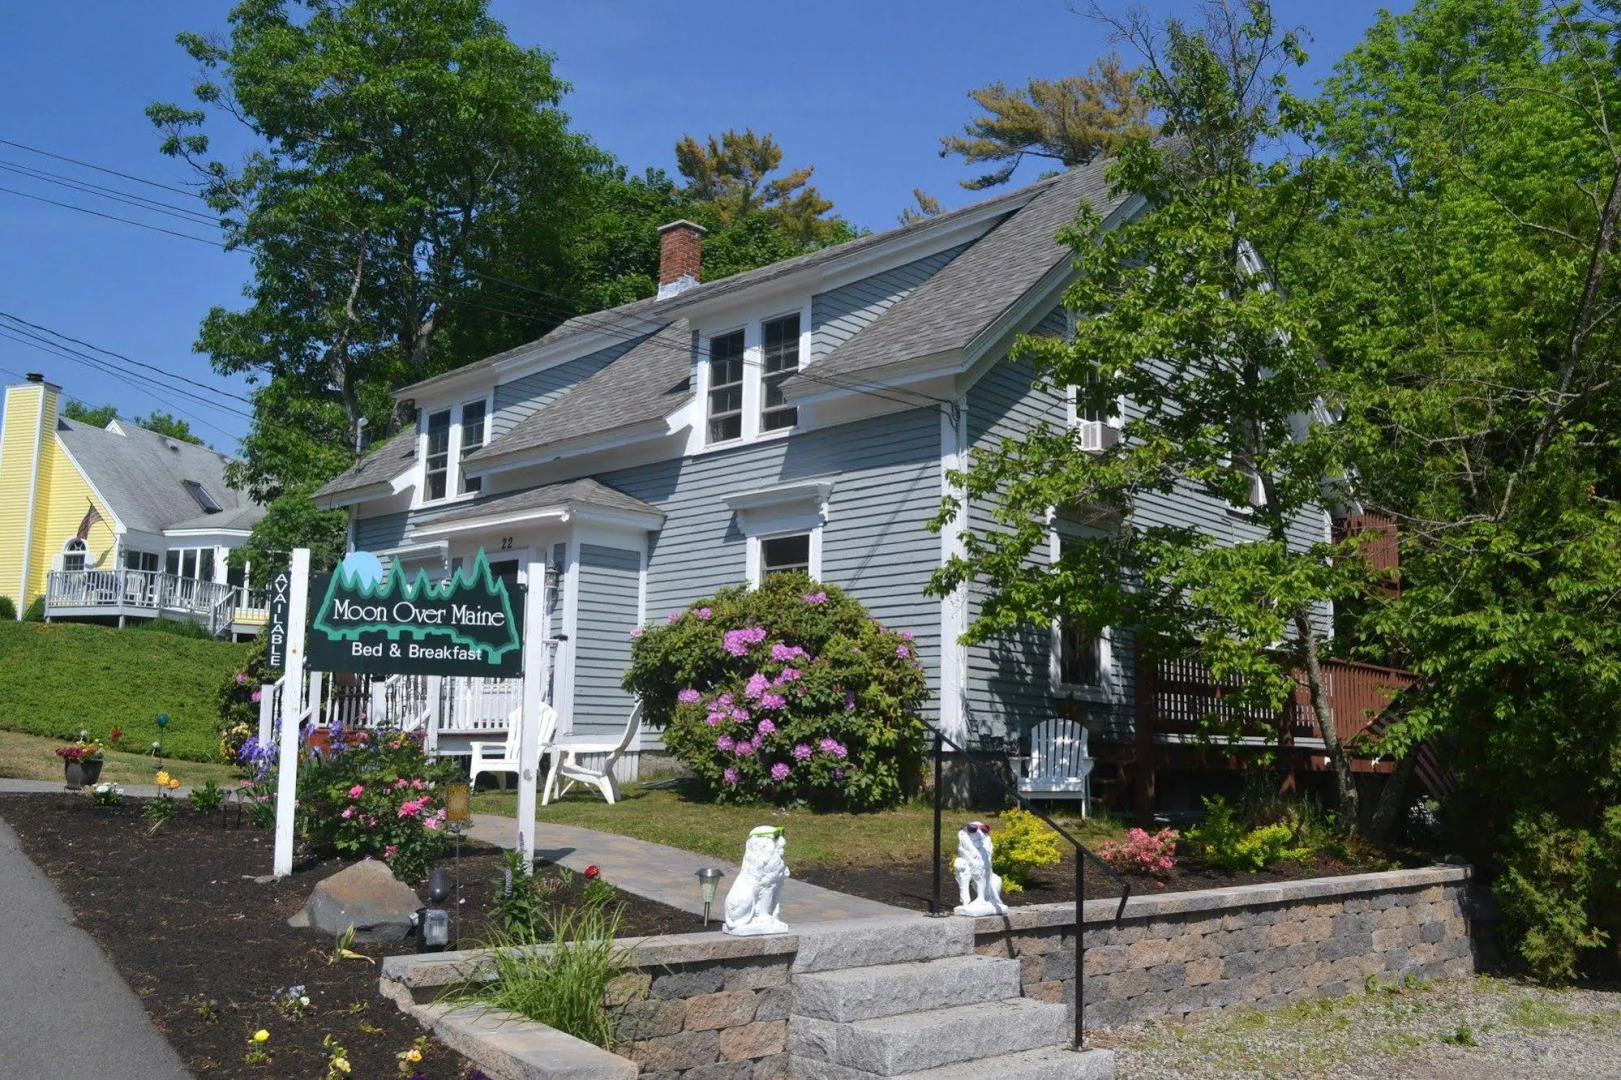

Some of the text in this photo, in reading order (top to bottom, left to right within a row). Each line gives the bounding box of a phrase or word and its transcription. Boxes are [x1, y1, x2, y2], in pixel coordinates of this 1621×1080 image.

[501, 536, 513, 549] 22
[270, 573, 288, 666] AVAILABLE
[333, 598, 505, 627] Moon Over Maine
[351, 641, 483, 661] Bed & Breakfast
